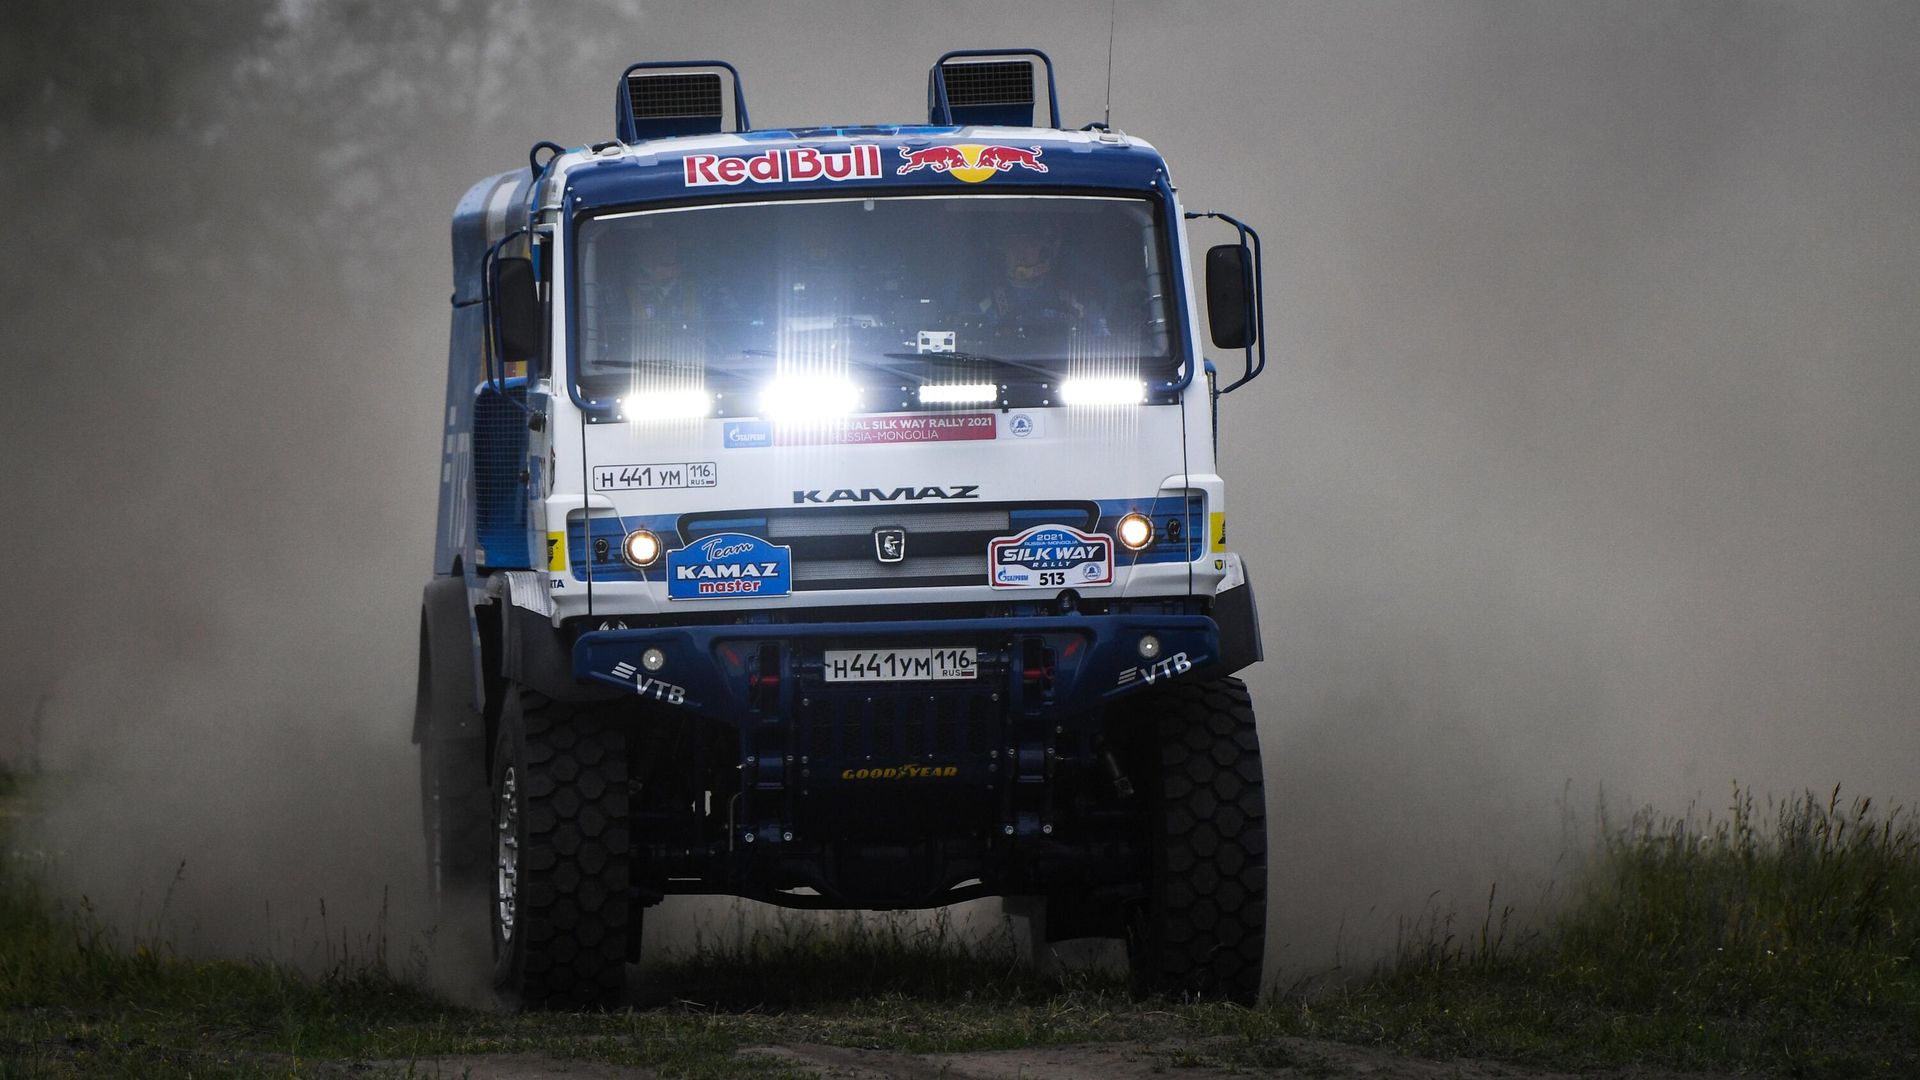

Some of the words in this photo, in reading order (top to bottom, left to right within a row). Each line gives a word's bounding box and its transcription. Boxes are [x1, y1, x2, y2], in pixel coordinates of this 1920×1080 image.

[685, 150, 782, 186] Red
[788, 145, 881, 181] Bull
[872, 420, 897, 430] SILK
[900, 419, 926, 429] WAY
[929, 418, 965, 428] RALLY
[967, 417, 992, 427] 2021
[619, 467, 651, 487] 441
[690, 465, 711, 477] 116
[793, 485, 979, 504] KAMAZ
[1036, 533, 1063, 541] 2021
[701, 538, 754, 562] Team
[1002, 547, 1052, 561] SILK
[1055, 546, 1100, 560] WAY
[676, 563, 779, 580] KAMAZ
[1039, 572, 1065, 586] 513
[699, 579, 761, 594] master
[934, 650, 970, 669] 116
[1139, 651, 1192, 685] VTB
[942, 669, 961, 677] RUS
[636, 673, 686, 705] VTB
[841, 765, 958, 780] GOODYEAR
